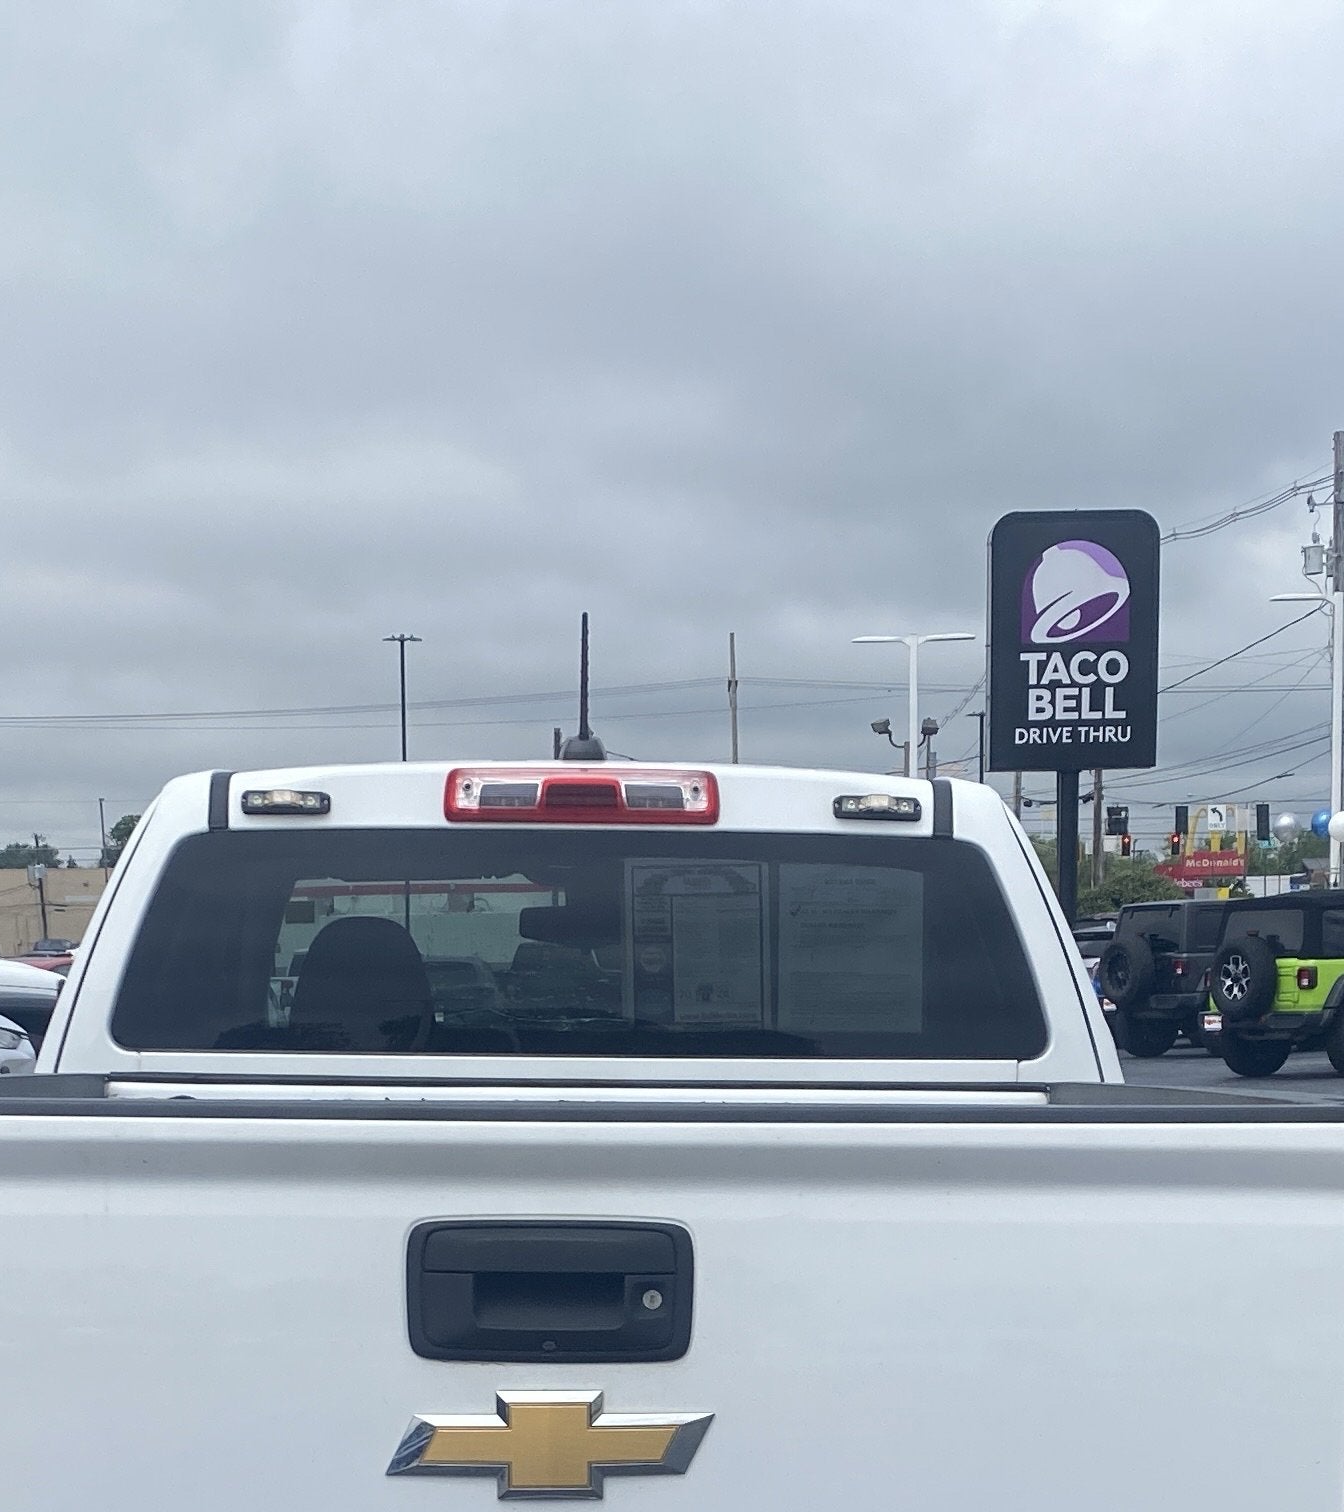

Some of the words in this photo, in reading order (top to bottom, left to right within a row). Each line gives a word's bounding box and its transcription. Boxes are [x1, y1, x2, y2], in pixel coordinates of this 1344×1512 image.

[1019, 650, 1129, 685] TACO
[1027, 687, 1127, 721] BELL
[1014, 726, 1073, 744] DRIVE
[1077, 725, 1131, 743] THRU
